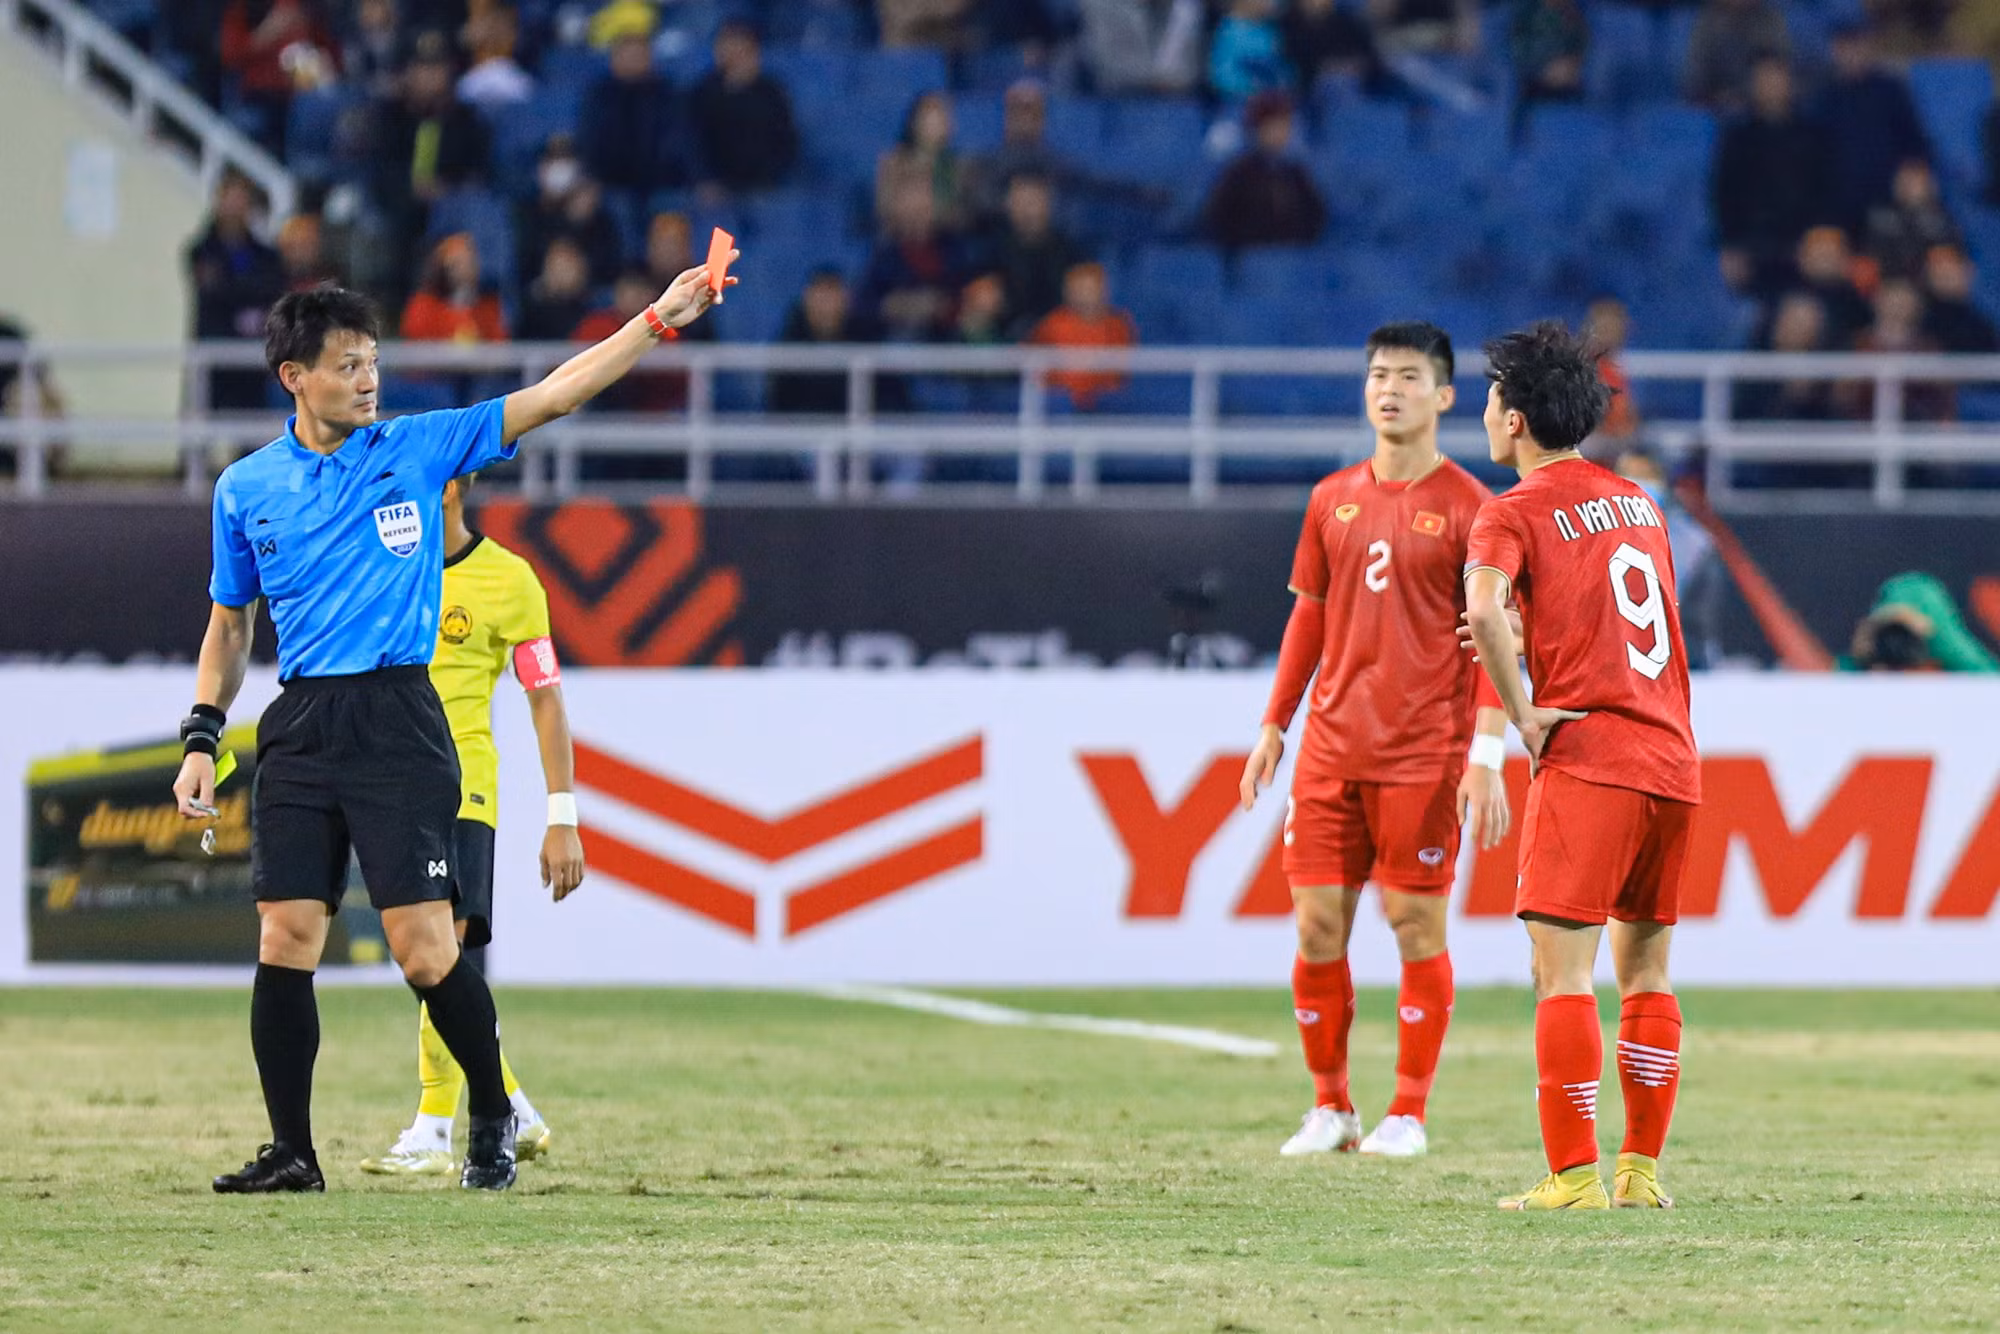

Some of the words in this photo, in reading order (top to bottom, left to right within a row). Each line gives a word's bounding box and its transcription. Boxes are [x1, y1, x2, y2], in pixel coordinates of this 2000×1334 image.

[378, 505, 414, 523] FIFA
[383, 525, 418, 538] REFEREE
[1574, 497, 1620, 534] VAN
[1611, 495, 1662, 528] TOAN
[1364, 538, 1392, 593] 2
[1608, 541, 1672, 680] 9
